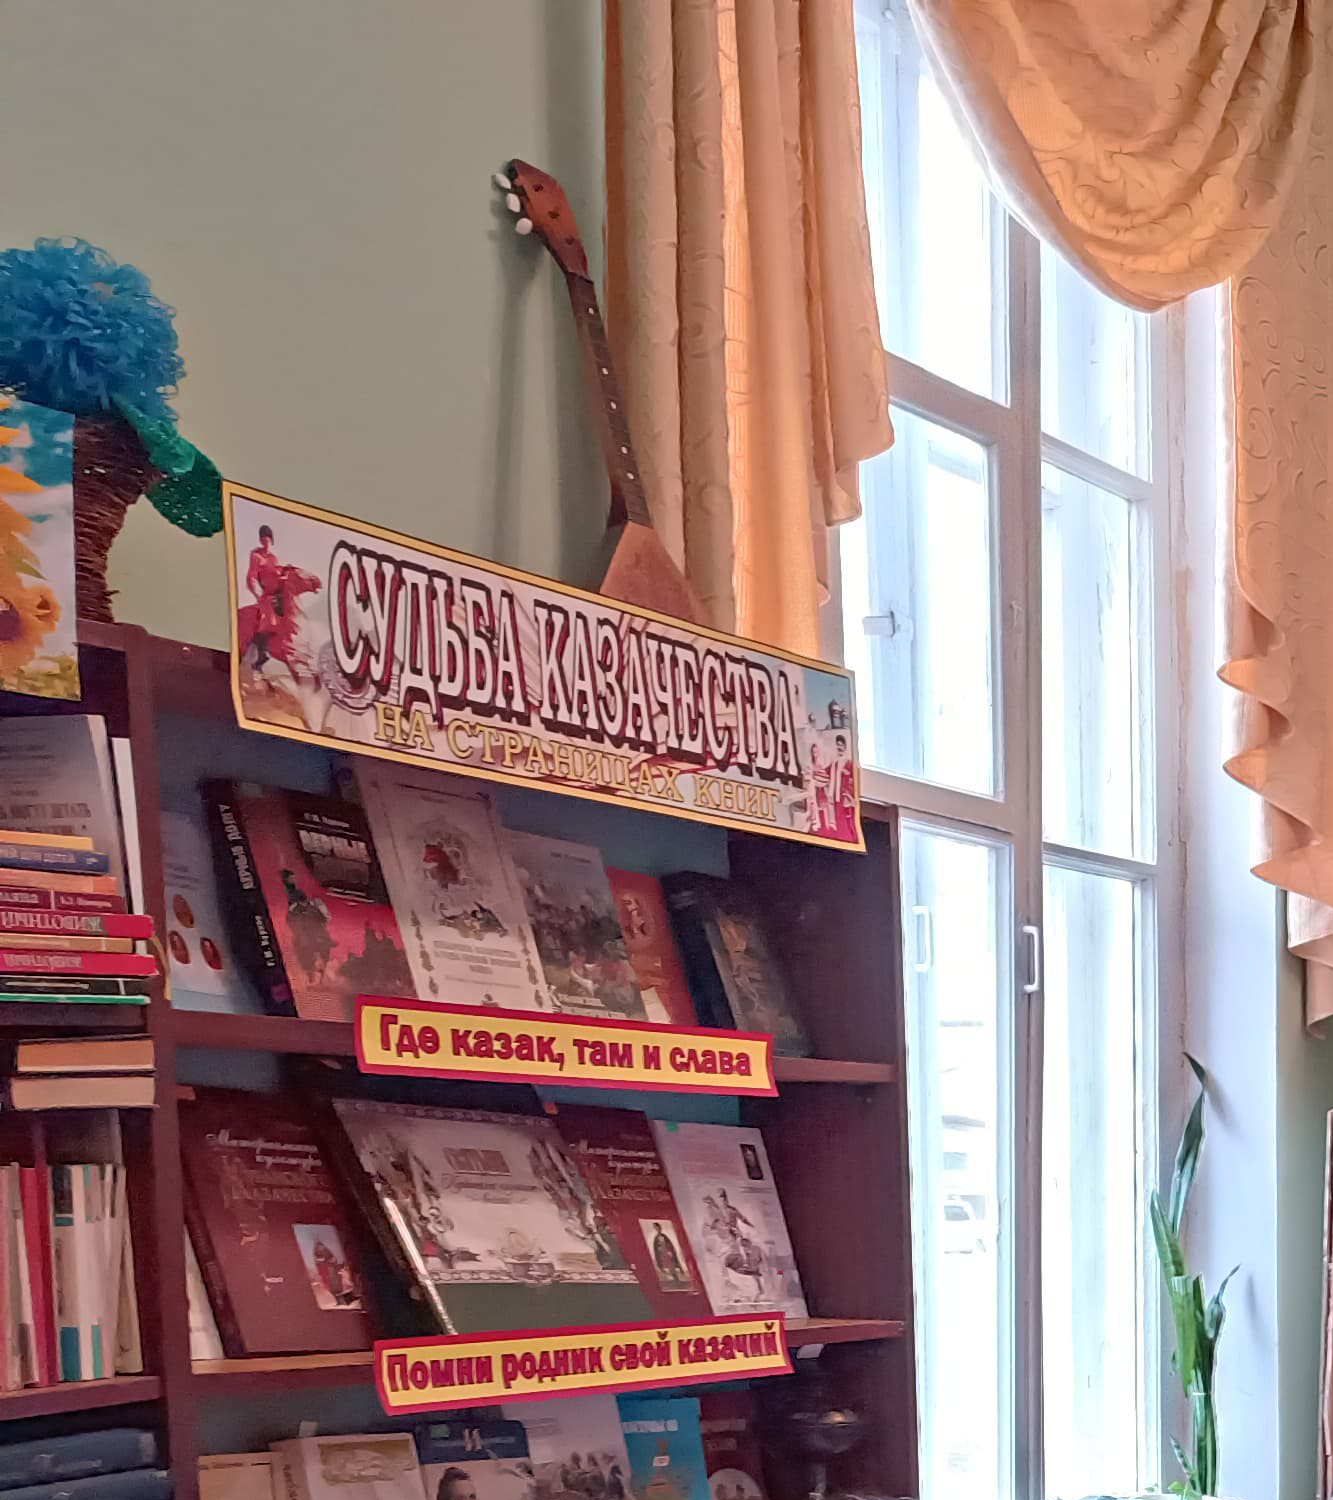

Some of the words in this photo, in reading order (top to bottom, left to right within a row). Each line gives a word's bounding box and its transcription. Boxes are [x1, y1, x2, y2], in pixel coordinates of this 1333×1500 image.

[328, 538, 538, 724] СУДЬБА
[531, 600, 804, 784] КАЗАЧЕСТВА
[373, 701, 434, 754] НА
[447, 721, 682, 803] СТРАНИЦАХ
[693, 775, 781, 821] КНИГ
[379, 1014, 440, 1061] Где
[451, 1027, 564, 1072] казак,
[575, 1039, 634, 1073] там
[642, 1044, 662, 1071] и
[669, 1047, 753, 1078] слава
[386, 1348, 494, 1396] Помни
[501, 1343, 603, 1391] родник
[607, 1329, 672, 1376] свой
[676, 1326, 780, 1367] казачий
